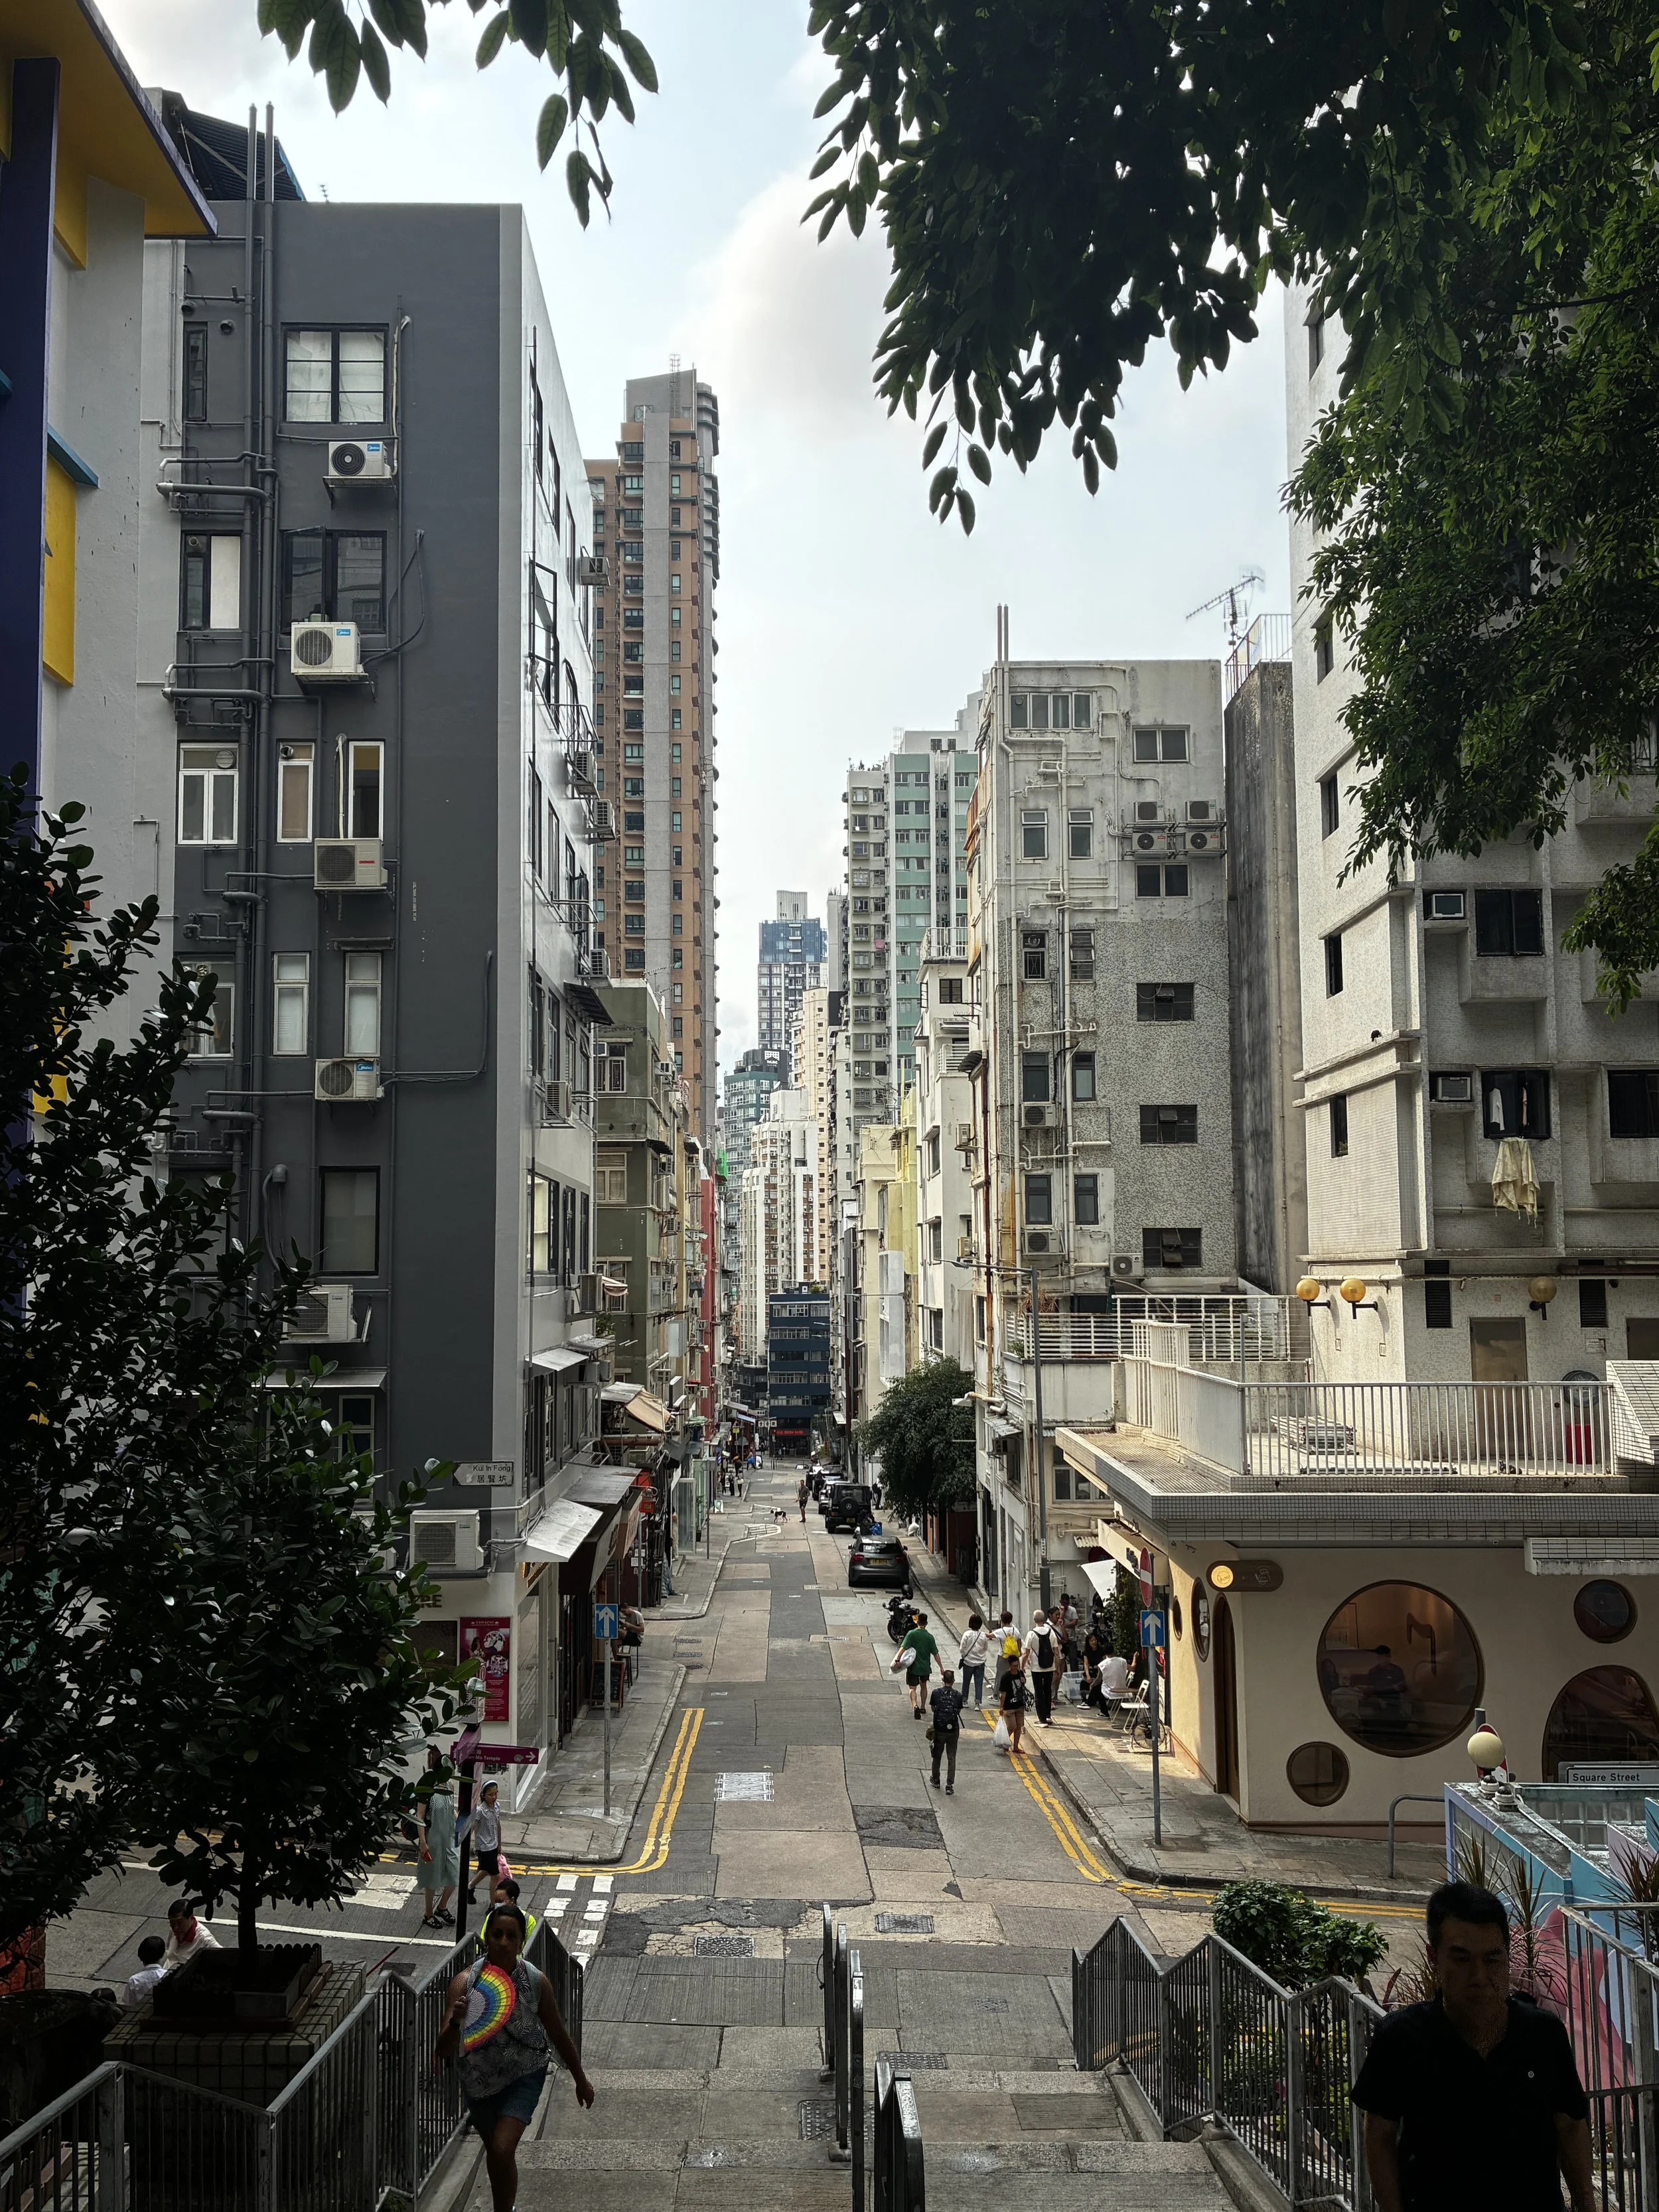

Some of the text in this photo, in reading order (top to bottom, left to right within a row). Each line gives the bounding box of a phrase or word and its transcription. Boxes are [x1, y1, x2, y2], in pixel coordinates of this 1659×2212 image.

[477, 1474, 507, 1484] 居賢坊
[1573, 1773, 1640, 1783] Square Street
